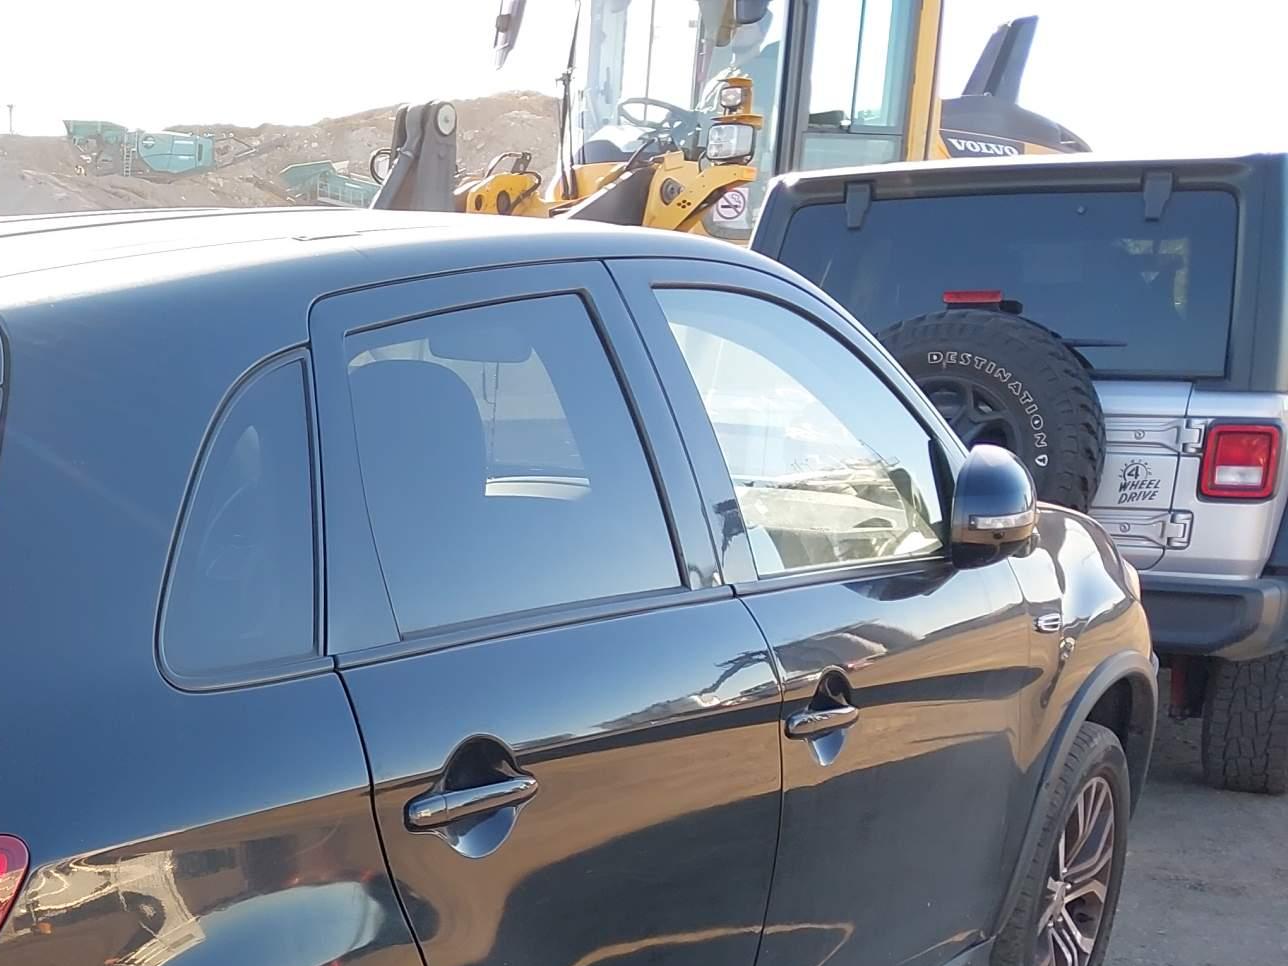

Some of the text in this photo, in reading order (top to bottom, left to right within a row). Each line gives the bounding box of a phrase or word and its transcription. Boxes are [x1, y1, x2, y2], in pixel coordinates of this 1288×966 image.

[947, 138, 1020, 156] VOLVO
[928, 352, 1048, 448] DESTINATION
[1126, 465, 1140, 480] 4
[1118, 479, 1161, 493] WHEEL
[1117, 490, 1159, 504] DRIVE
